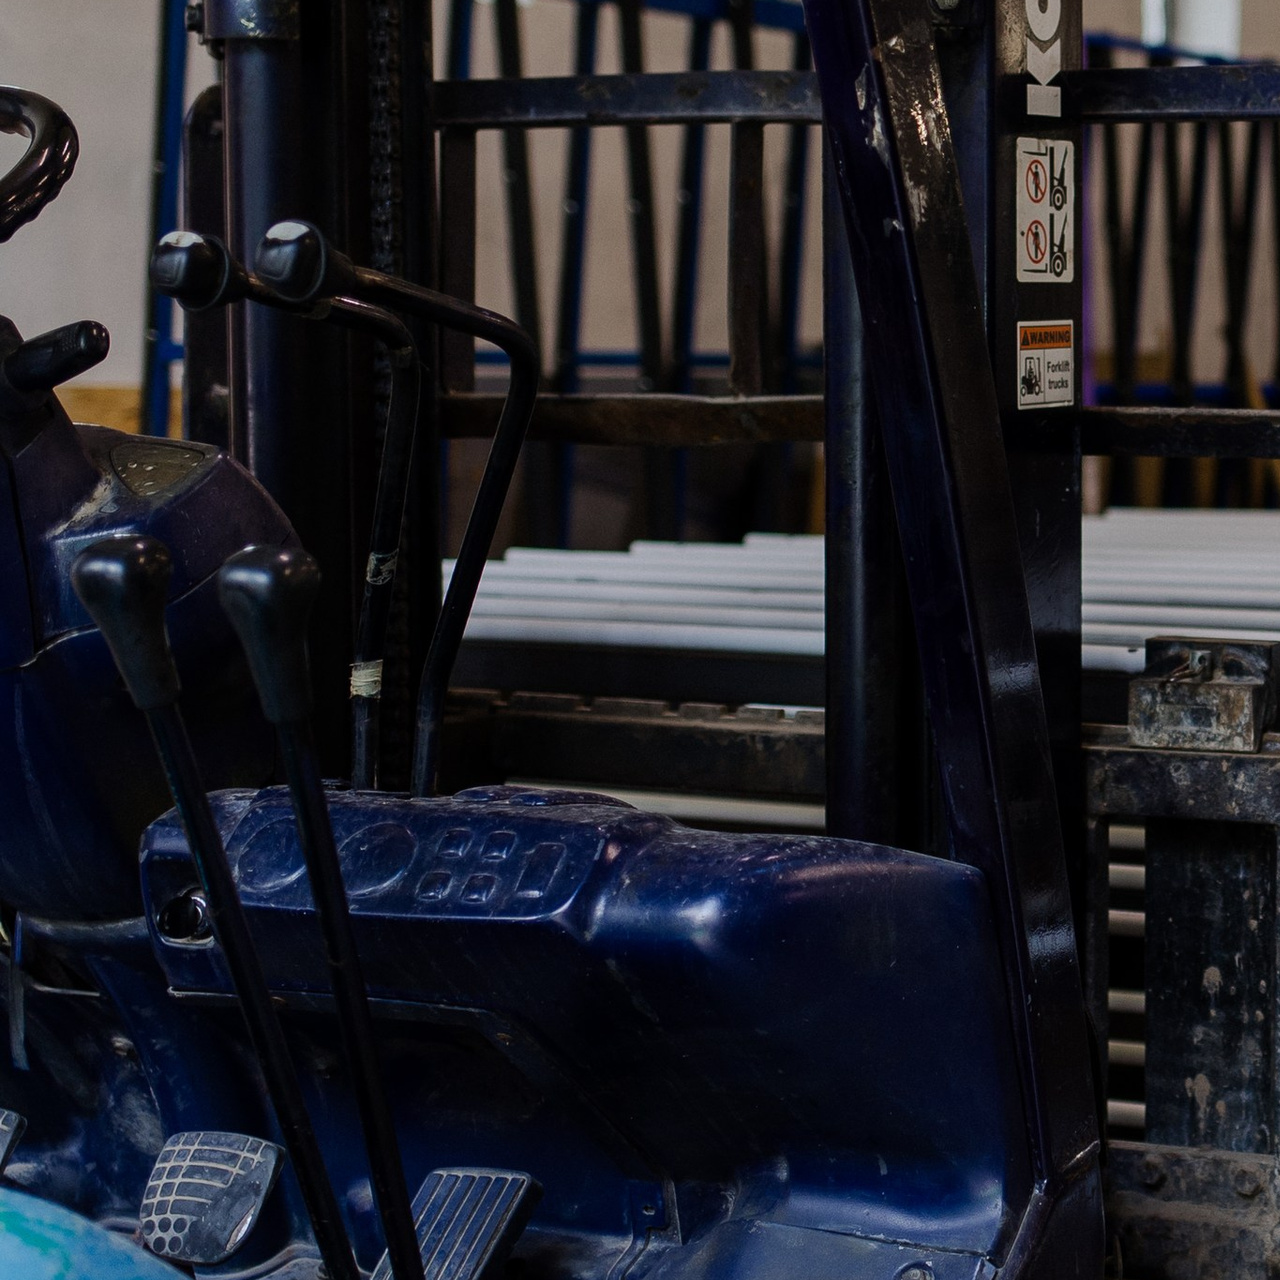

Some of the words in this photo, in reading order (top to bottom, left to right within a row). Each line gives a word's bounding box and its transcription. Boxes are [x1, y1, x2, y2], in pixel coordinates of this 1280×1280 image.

[1029, 330, 1070, 344] WARNING
[1046, 361, 1070, 373] Forklift
[1048, 377, 1069, 390] trucks
